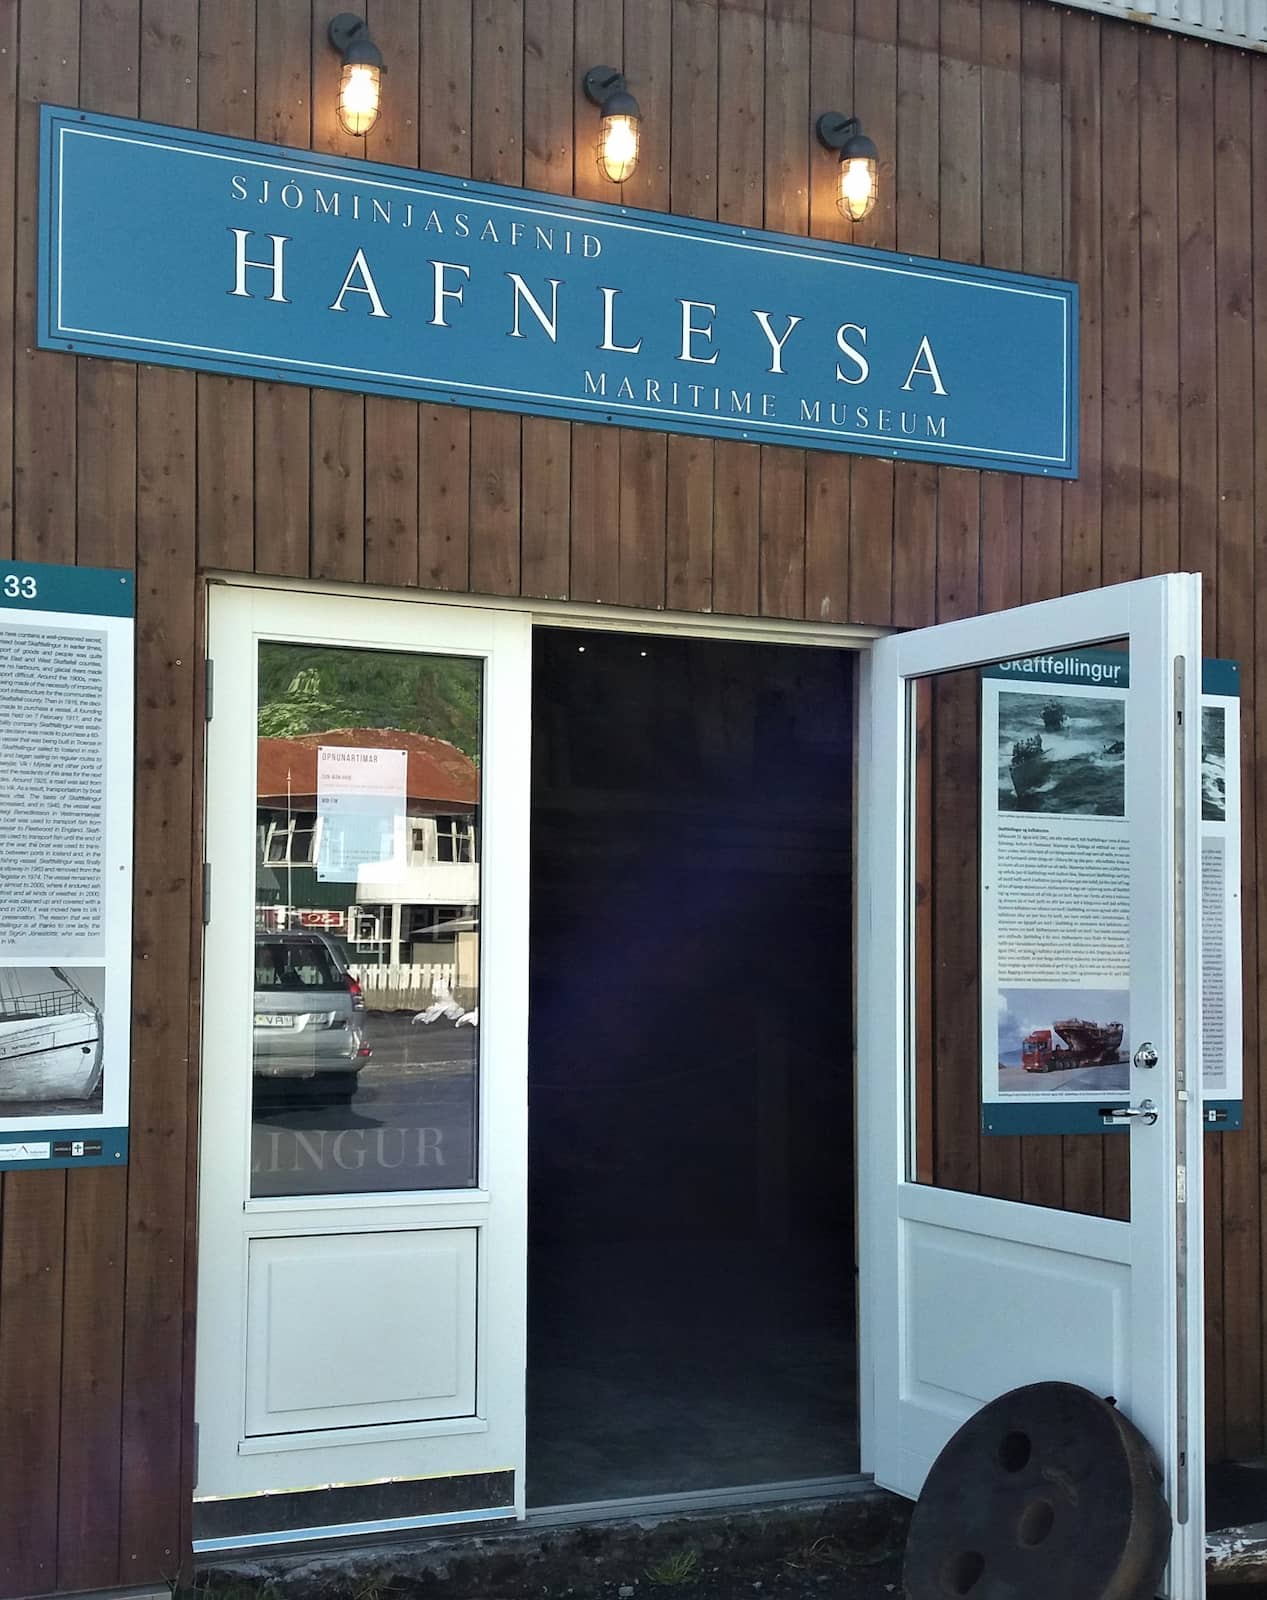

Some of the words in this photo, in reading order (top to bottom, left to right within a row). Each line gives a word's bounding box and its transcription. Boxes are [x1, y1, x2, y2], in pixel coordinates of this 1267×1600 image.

[226, 227, 949, 396] HAFNLEYSA
[584, 370, 777, 416] MARITIME
[800, 399, 948, 438] MUSEUM
[4, 574, 37, 599] 33
[252, 1127, 447, 1172] INGUR
